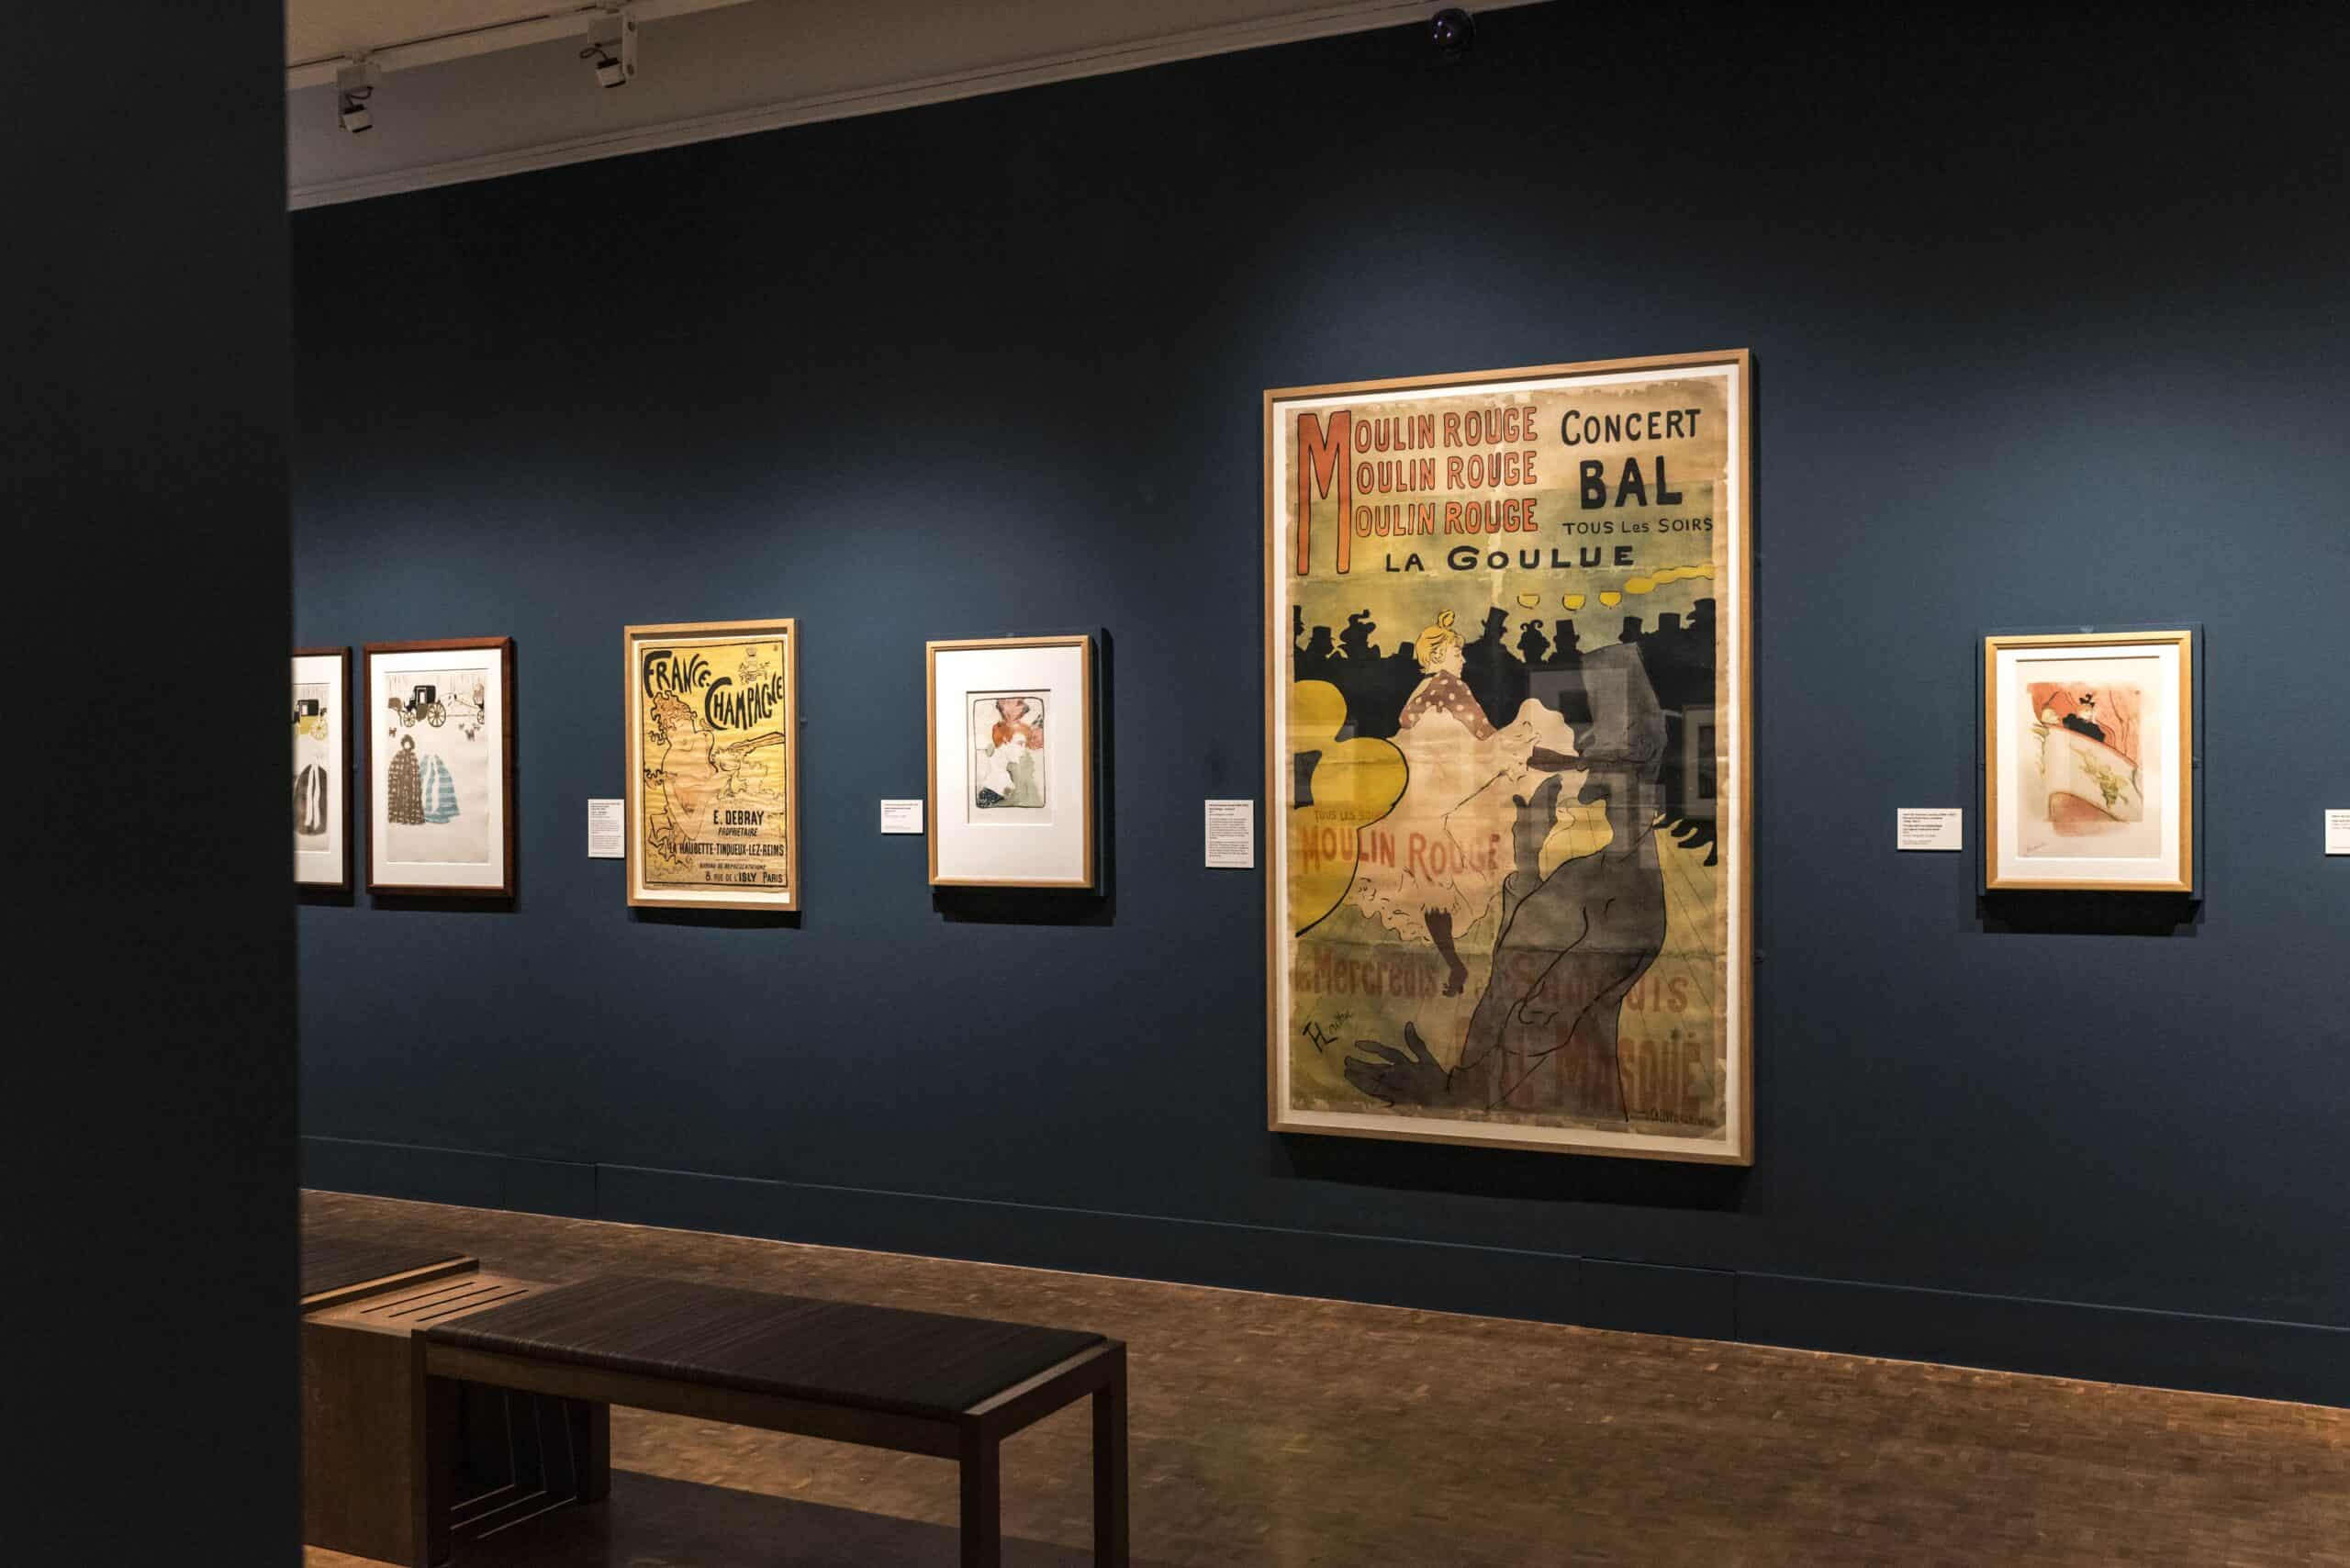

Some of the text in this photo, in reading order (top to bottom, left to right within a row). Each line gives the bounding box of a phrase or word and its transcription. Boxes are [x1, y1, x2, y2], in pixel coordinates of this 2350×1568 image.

[1443, 407, 1538, 448] ROUGE
[1561, 409, 1701, 446] CONCERT
[1447, 451, 1538, 490] ROUGE
[1580, 455, 1683, 510] BAL
[1444, 498, 1539, 535] ROUGE
[1562, 521, 1614, 535] TOUS
[1659, 518, 1714, 532] SOIRS
[1385, 544, 1635, 573] LA GOULUE
[704, 671, 783, 731] CHAMPAGNE
[725, 811, 764, 825] DEBRAY
[1302, 825, 1395, 874] MOULIN
